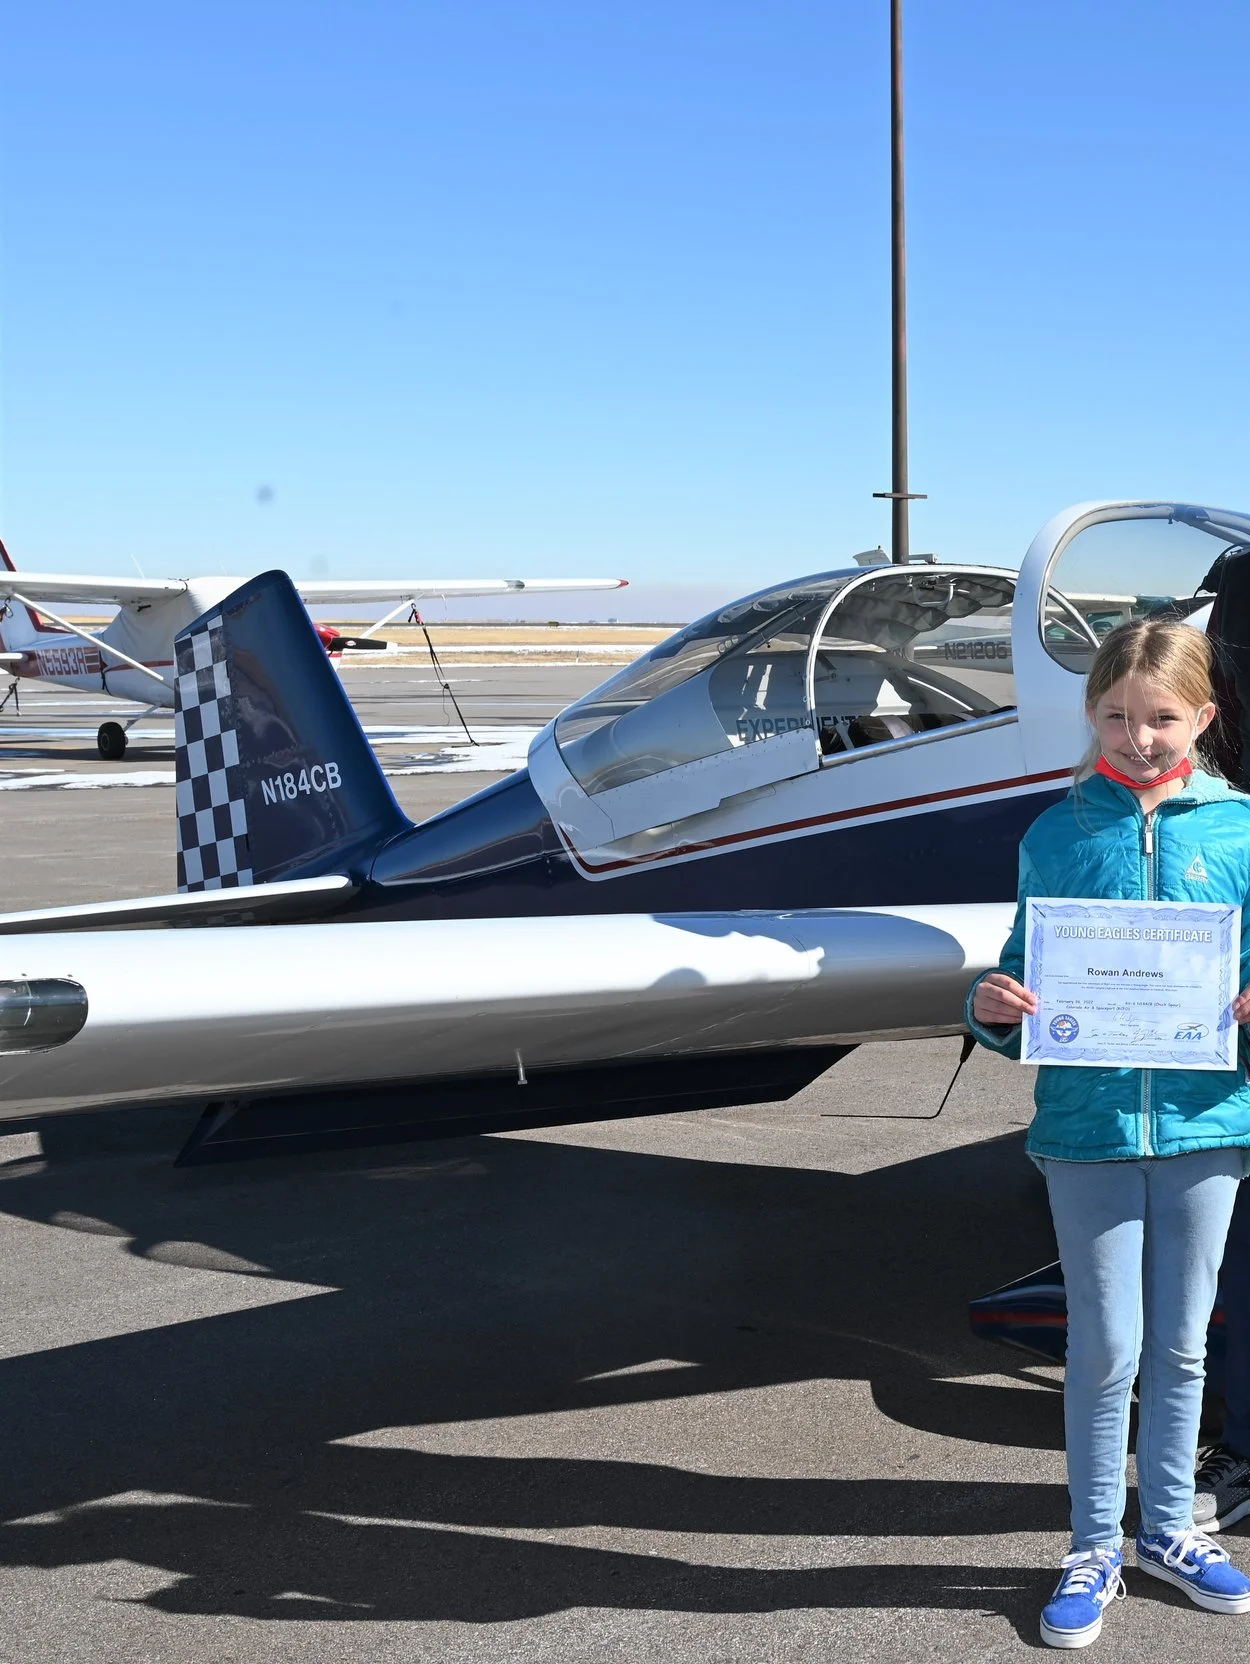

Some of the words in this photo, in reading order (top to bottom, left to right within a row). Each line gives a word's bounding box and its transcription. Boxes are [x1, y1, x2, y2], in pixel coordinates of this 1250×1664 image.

[261, 762, 342, 806] N184CB
[1055, 925, 1095, 939] YOUNG
[1097, 927, 1140, 940] EAGLES
[1143, 929, 1213, 943] CERTIFICATE
[1087, 967, 1120, 977] Rowan
[1122, 968, 1164, 978] Andrews
[1173, 1031, 1202, 1040] EAA
